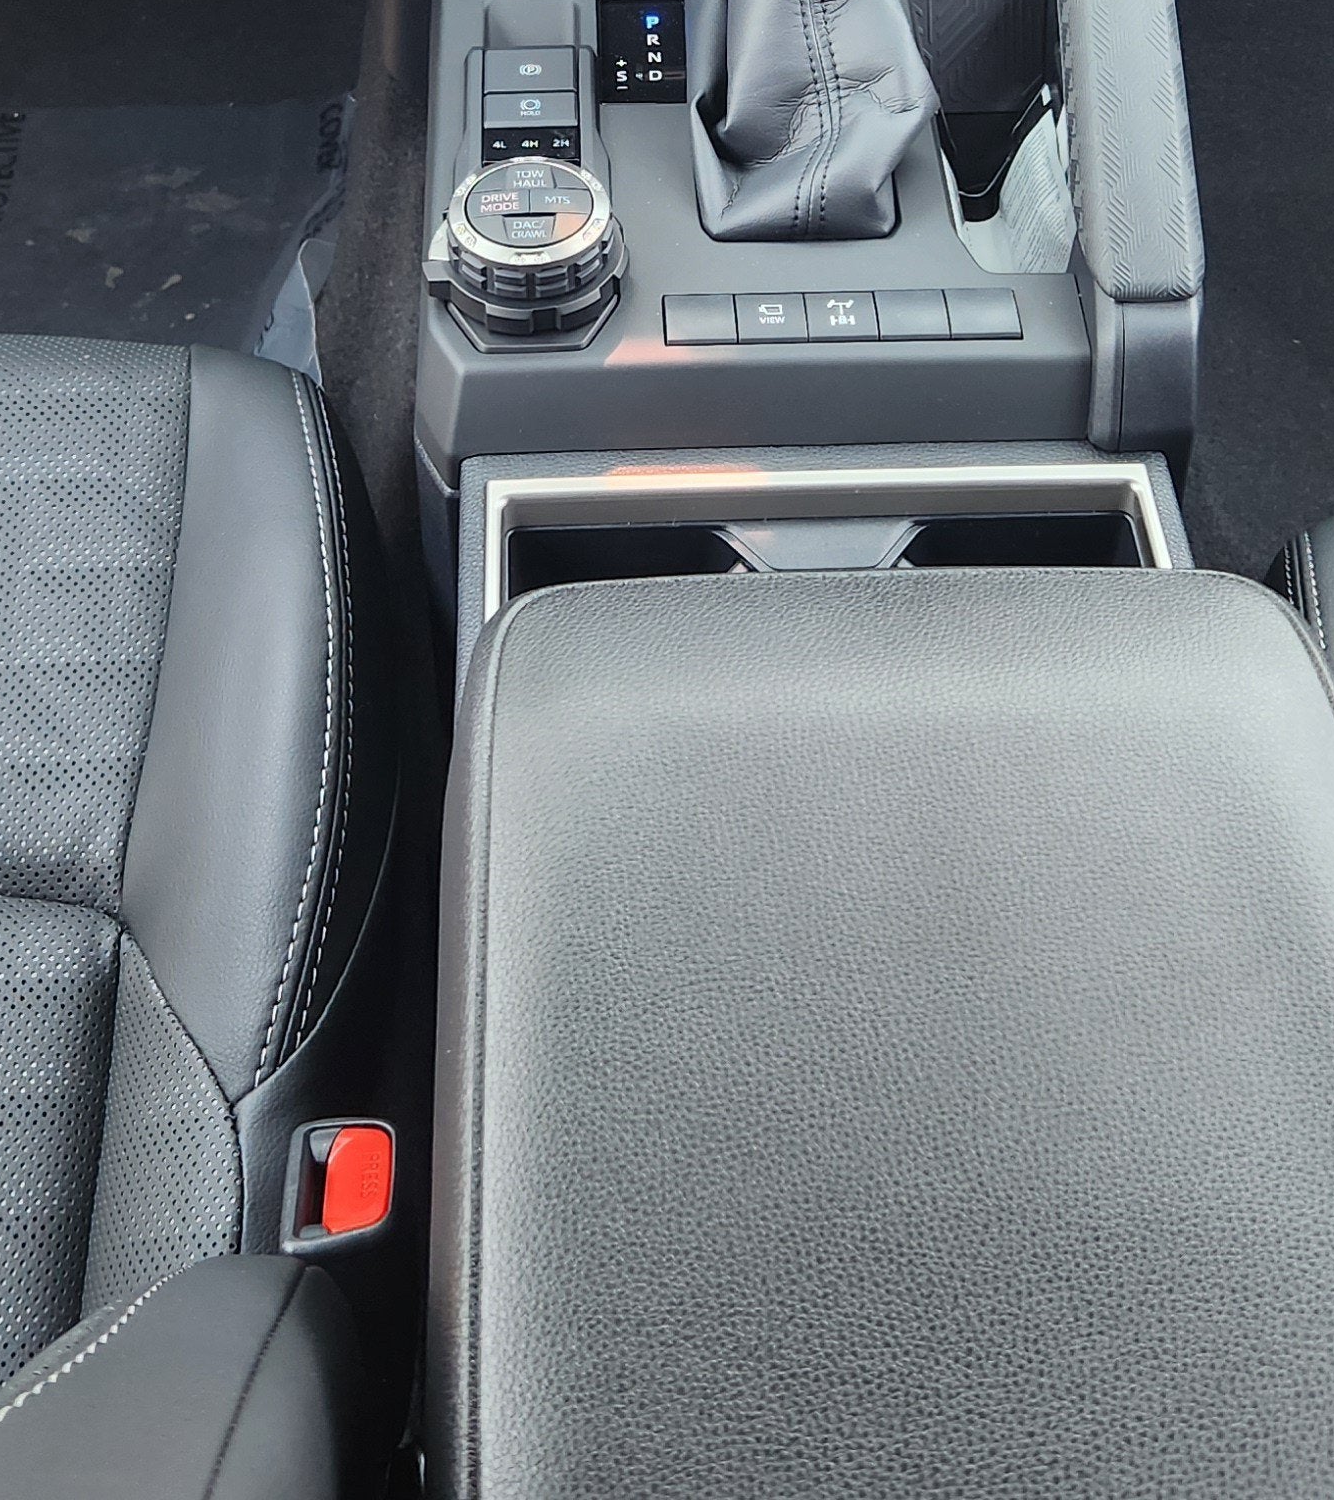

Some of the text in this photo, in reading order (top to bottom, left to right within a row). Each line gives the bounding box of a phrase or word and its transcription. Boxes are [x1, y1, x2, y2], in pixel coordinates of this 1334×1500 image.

[645, 16, 660, 30] P
[646, 33, 661, 46] R
[648, 51, 662, 63] N
[616, 70, 628, 82] S
[648, 69, 663, 82] D
[492, 140, 507, 149] 4L
[521, 139, 539, 148] 4H
[552, 138, 570, 148] 2H
[516, 170, 545, 179] TOW
[513, 180, 547, 188] HAUL
[481, 191, 520, 203] DRIVE
[544, 195, 571, 205] MTS
[480, 202, 520, 213] MODE
[511, 230, 547, 239] CRAWL
[758, 315, 786, 325] VIEW
[360, 1152, 380, 1199] PRESS
